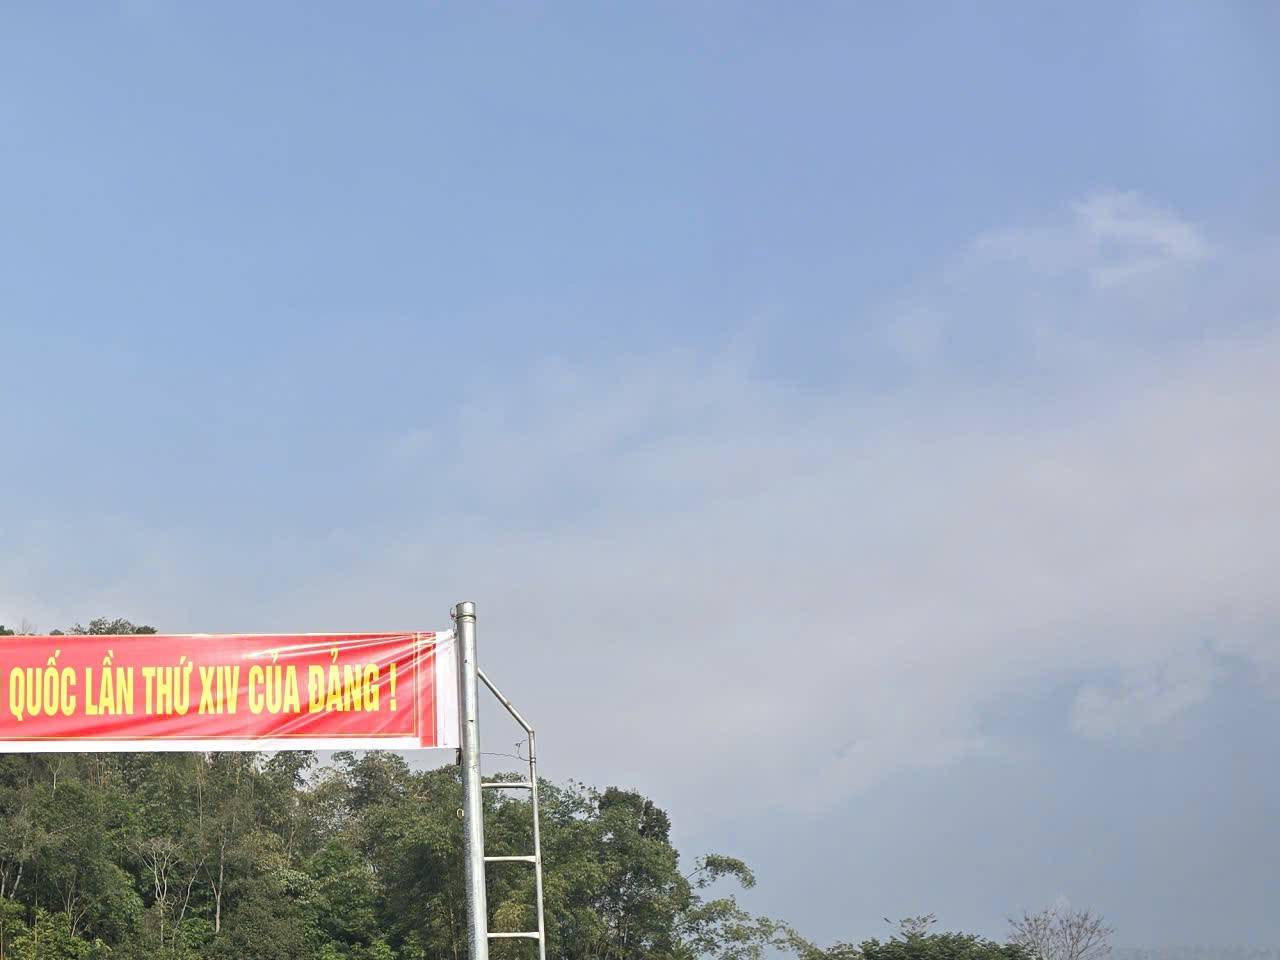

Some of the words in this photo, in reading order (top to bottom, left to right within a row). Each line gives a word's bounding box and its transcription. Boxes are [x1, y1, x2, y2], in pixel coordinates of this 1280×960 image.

[9, 650, 76, 721] QUỐC
[85, 650, 134, 715] LẦN
[142, 655, 192, 714] THỨ
[199, 666, 240, 714] XIV
[248, 652, 300, 714] CỦA
[308, 648, 380, 713] ĐẢNG
[389, 663, 398, 712] !
